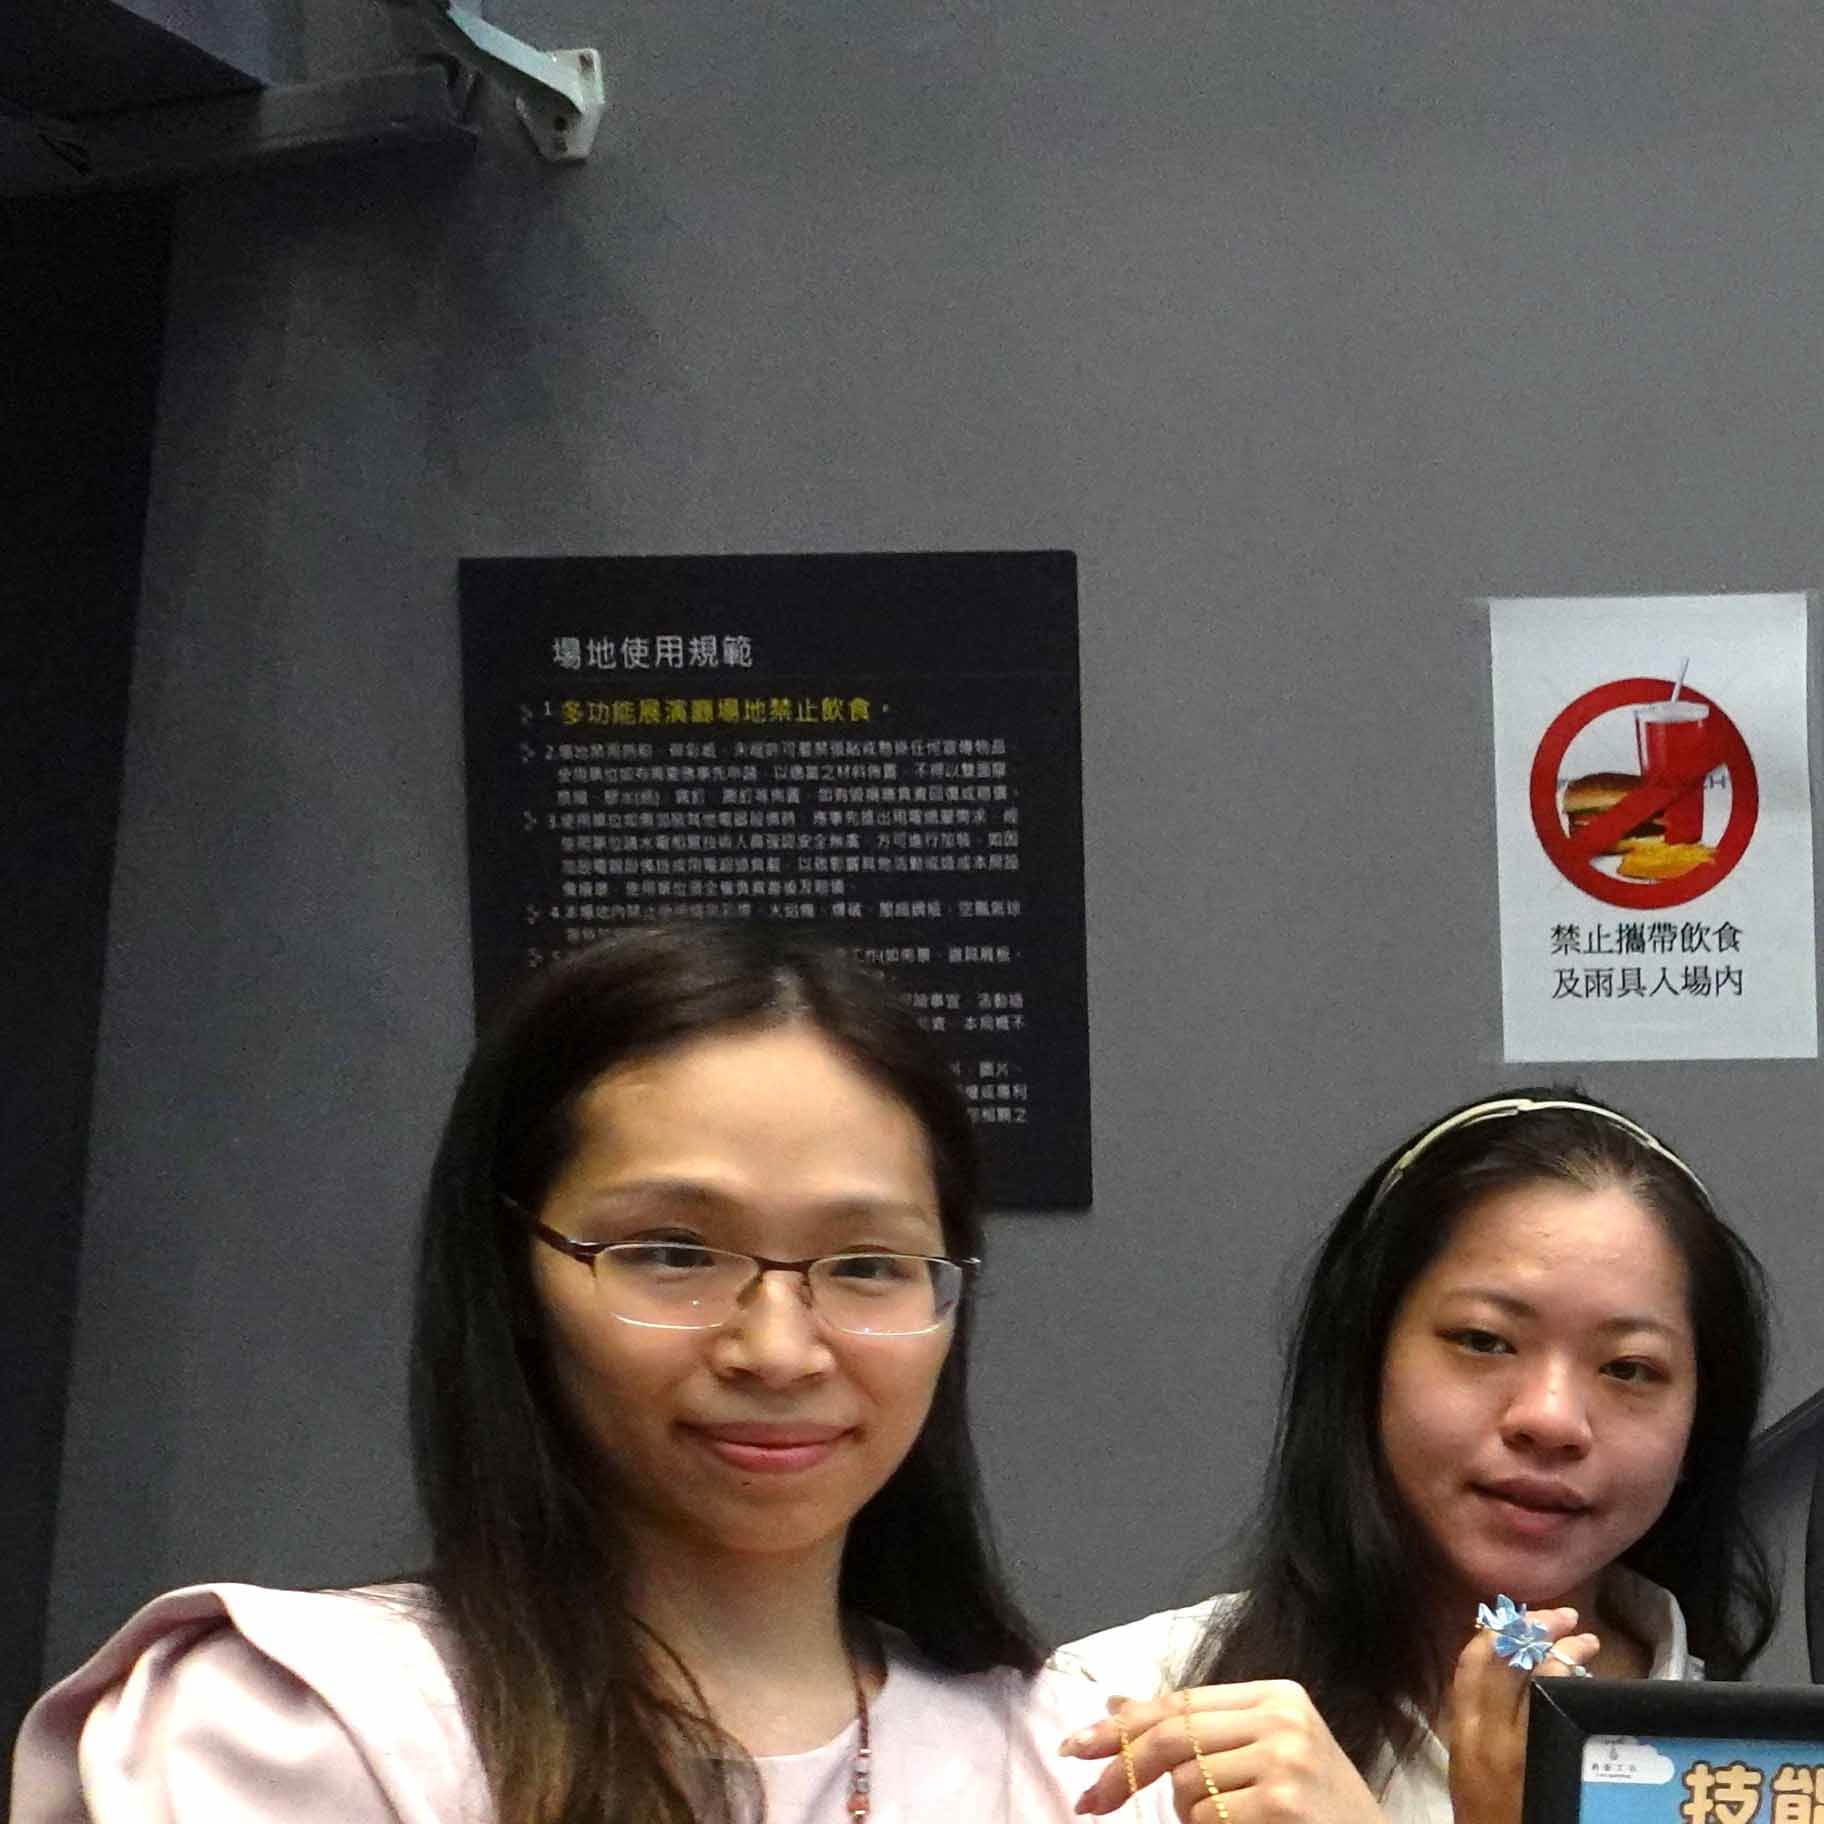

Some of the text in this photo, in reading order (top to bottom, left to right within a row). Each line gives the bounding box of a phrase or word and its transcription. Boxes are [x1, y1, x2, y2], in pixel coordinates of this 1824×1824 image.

[552, 635, 753, 670] 場地使用規範
[1550, 920, 1743, 956] 禁止攜帶飲食
[1551, 965, 1743, 999] 及雨具入場內
